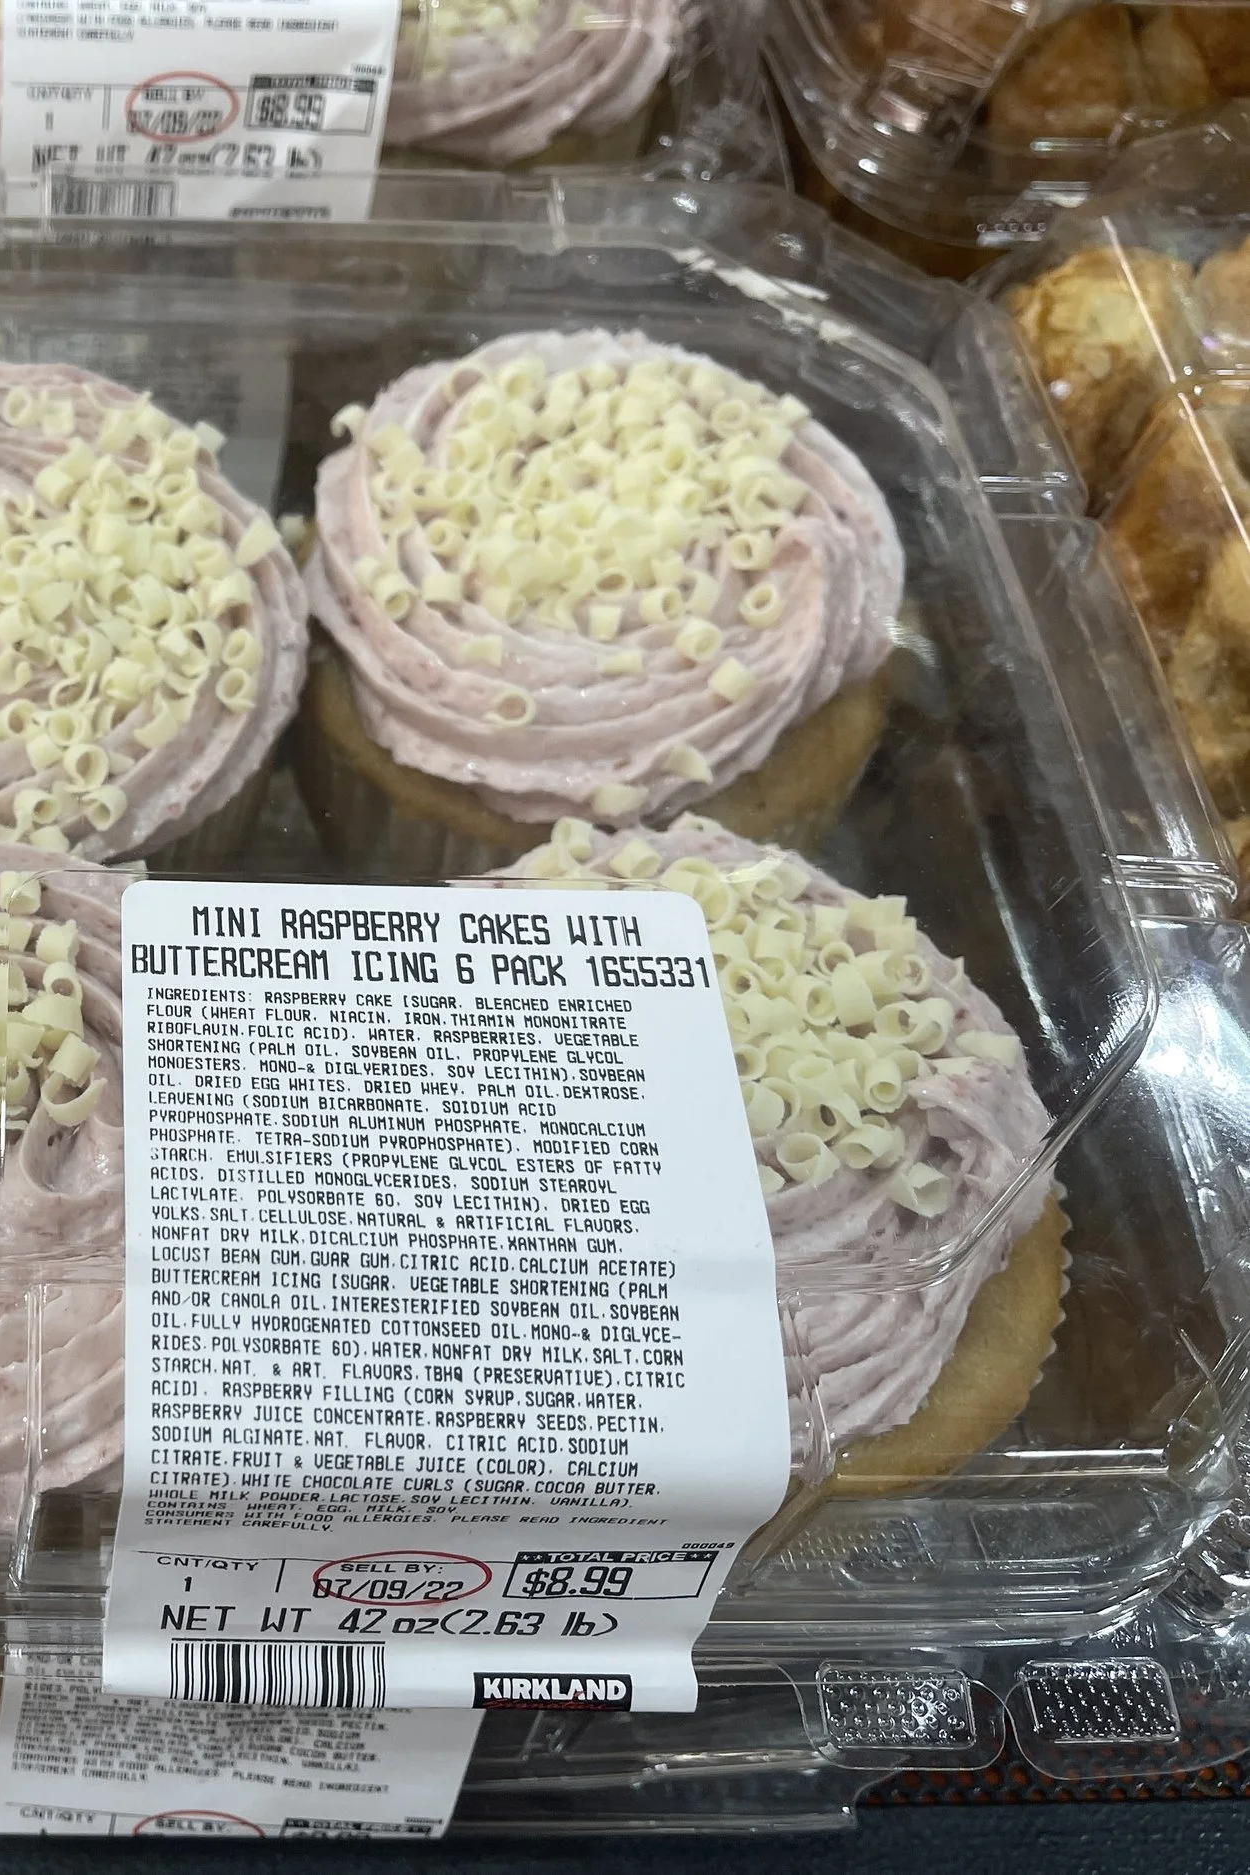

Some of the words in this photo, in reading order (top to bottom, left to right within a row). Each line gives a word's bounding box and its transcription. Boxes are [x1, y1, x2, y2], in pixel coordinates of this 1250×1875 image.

[192, 905, 261, 938] MINI
[281, 908, 440, 943] RASPBERRY
[459, 912, 551, 946] CAKES
[566, 915, 642, 947] WITH
[131, 944, 330, 981] BUTTERCREAM
[351, 950, 439, 984] ICING
[455, 953, 475, 985] 6
[491, 954, 567, 987] PACK
[585, 955, 710, 988] 1655331
[264, 991, 346, 1006] RASPBERRY
[356, 993, 393, 1007] CAKE
[475, 996, 549, 1012] BLEACHED
[558, 998, 632, 1013] ENRICHED
[147, 1004, 192, 1018] FLOUR
[201, 1005, 256, 1020] (WHEAT
[523, 1015, 627, 1030] MONONITRATE
[554, 1032, 639, 1047] VEGETABLE
[147, 1038, 241, 1054] SHORTENING
[249, 1041, 296, 1056] (PALM
[351, 1045, 417, 1060] SOYBEAN
[472, 1048, 558, 1064] PROPYLENE
[566, 1050, 624, 1065] GLYCOL
[447, 1064, 475, 1079] SOY
[195, 1075, 242, 1089] DRIED
[251, 1076, 280, 1091] EGG
[364, 1080, 412, 1095] DRIED
[477, 1083, 516, 1098] PALM
[149, 1090, 234, 1107] LEAVENING
[242, 1094, 309, 1110] (SODIUM
[441, 1100, 509, 1116] SOIDIUM
[518, 1102, 557, 1117] ACID
[348, 1115, 425, 1132] ALUMINUM
[539, 1121, 646, 1137] MONOCALCIUM
[255, 1131, 370, 1149] TETRA-SODIUM
[533, 1139, 611, 1156] MODIFIED
[620, 1141, 659, 1156] CORN
[227, 1149, 333, 1167] EMULSIFIERS
[342, 1152, 439, 1170] (PROPYLENE
[448, 1156, 507, 1172] GLYCOL
[516, 1158, 575, 1174] ESTERS
[584, 1159, 603, 1174] OF
[613, 1160, 662, 1176] FATTY
[218, 1168, 305, 1185] DISTILLED
[470, 1176, 529, 1192] SODIUM
[538, 1177, 617, 1194] STEAROYL
[257, 1189, 365, 1207] POLYSORBATE
[414, 1193, 443, 1209] SOY
[561, 1197, 610, 1214] DRIED
[619, 1199, 651, 1215] EGG
[151, 1225, 210, 1241] NONFAT
[220, 1227, 249, 1243] DRY
[436, 1216, 445, 1229] &
[455, 1214, 555, 1232] ARTIFICIAL
[152, 1245, 210, 1263] LOCUST
[221, 1247, 260, 1265] BEAN
[598, 1259, 676, 1279] ACETATE)
[151, 1267, 260, 1287] BUTTERCREAM
[272, 1271, 321, 1289] ICING
[410, 1275, 499, 1295] VEGETABLE
[510, 1278, 609, 1298] SHORTENING
[619, 1281, 668, 1300] (PALM
[151, 1290, 211, 1308] AND/OR
[221, 1292, 280, 1310] CANOLA
[490, 1300, 560, 1319] SOYBEAN
[251, 1315, 371, 1335] HYDROGENATED
[381, 1319, 481, 1339] COTTONSEED
[601, 1325, 681, 1344] DIGLYCE-
[502, 1345, 532, 1362] DRY
[272, 1363, 281, 1377] &
[222, 1381, 312, 1401] RASPBERRY
[323, 1384, 394, 1403] FILLING
[404, 1386, 454, 1406] (CORN
[151, 1402, 242, 1421] RASPBERRY
[253, 1405, 303, 1423] JUICE
[152, 1425, 212, 1443] SODIUM
[446, 1434, 507, 1452] CITRIC
[294, 1455, 303, 1469] &
[314, 1453, 405, 1472] VEGETABLE
[416, 1456, 466, 1474] JUICE
[567, 1460, 638, 1478] CALCIUM
[149, 1489, 198, 1500] WHOLE
[209, 1490, 250, 1501] MILK
[302, 1475, 393, 1490] CHOCOLATE
[404, 1477, 454, 1492] CURLS
[143, 1518, 231, 1528] STATEMENT
[146, 1509, 235, 1518] CONSUMERS
[244, 1511, 285, 1519] WITH
[293, 1512, 334, 1523] FOOD
[450, 1515, 511, 1523] PLEASE
[519, 1516, 560, 1524] READ
[568, 1516, 668, 1525] INGREDIENT
[156, 1555, 260, 1571] CNT/QTY
[339, 1563, 398, 1574] SELL
[403, 1563, 444, 1575] BY:
[548, 1552, 617, 1563] TOTAL
[619, 1552, 688, 1563] PRICE
[183, 1575, 193, 1592] 1
[312, 1578, 464, 1600] 07/09/22
[521, 1565, 633, 1596] $8.99
[160, 1604, 236, 1631] NET
[260, 1606, 311, 1633] WT
[561, 1611, 618, 1637] lb)
[483, 1677, 627, 1701] KIRKLAND
